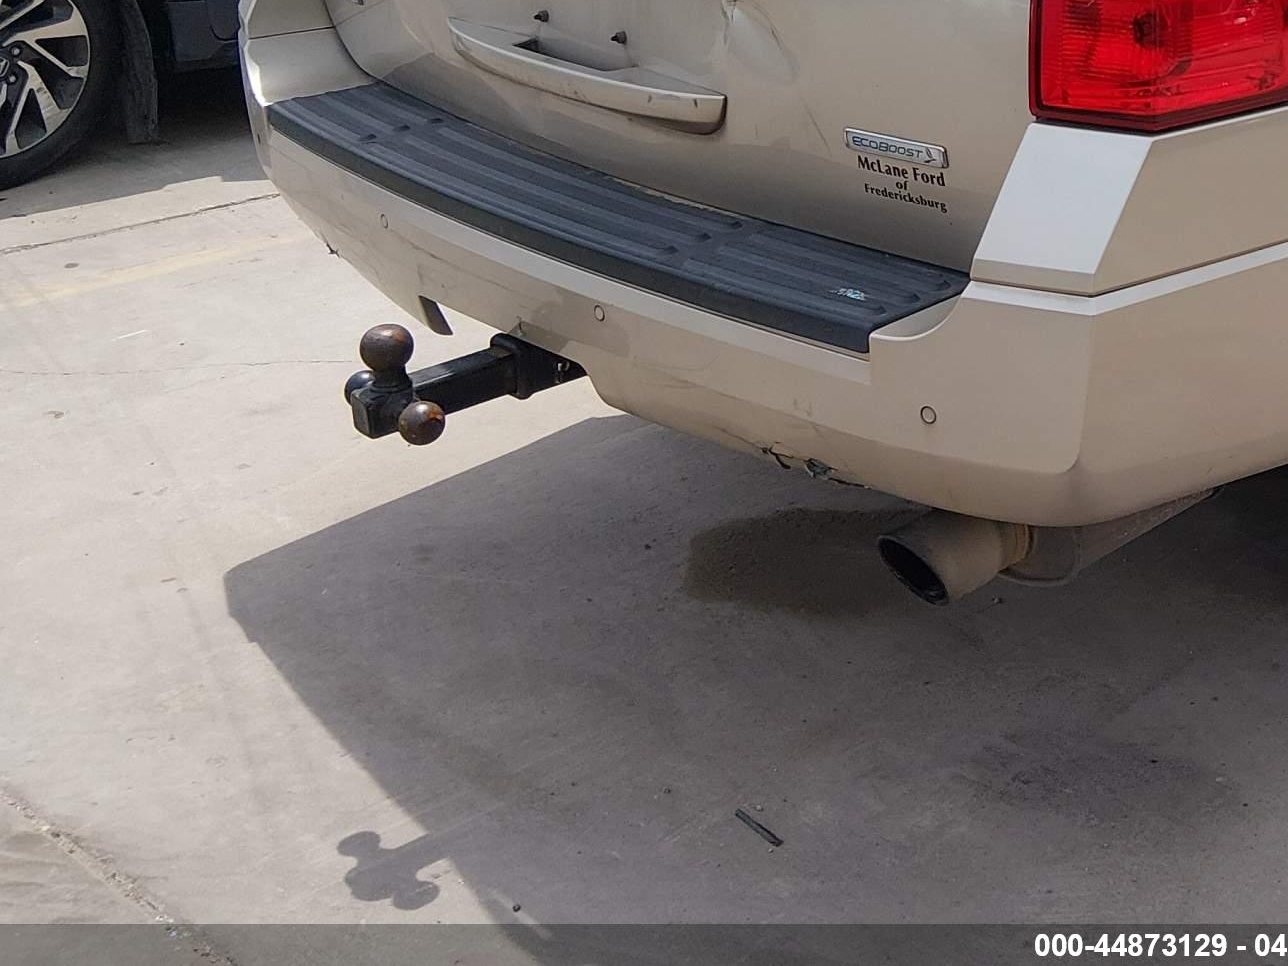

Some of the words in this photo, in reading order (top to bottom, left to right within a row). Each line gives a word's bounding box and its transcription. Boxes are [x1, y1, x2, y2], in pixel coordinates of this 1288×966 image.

[852, 136, 924, 158] ECOBOOST
[857, 155, 909, 179] McLane
[912, 167, 946, 187] Ford
[864, 183, 948, 214] Fredericksburg
[895, 180, 909, 191] of
